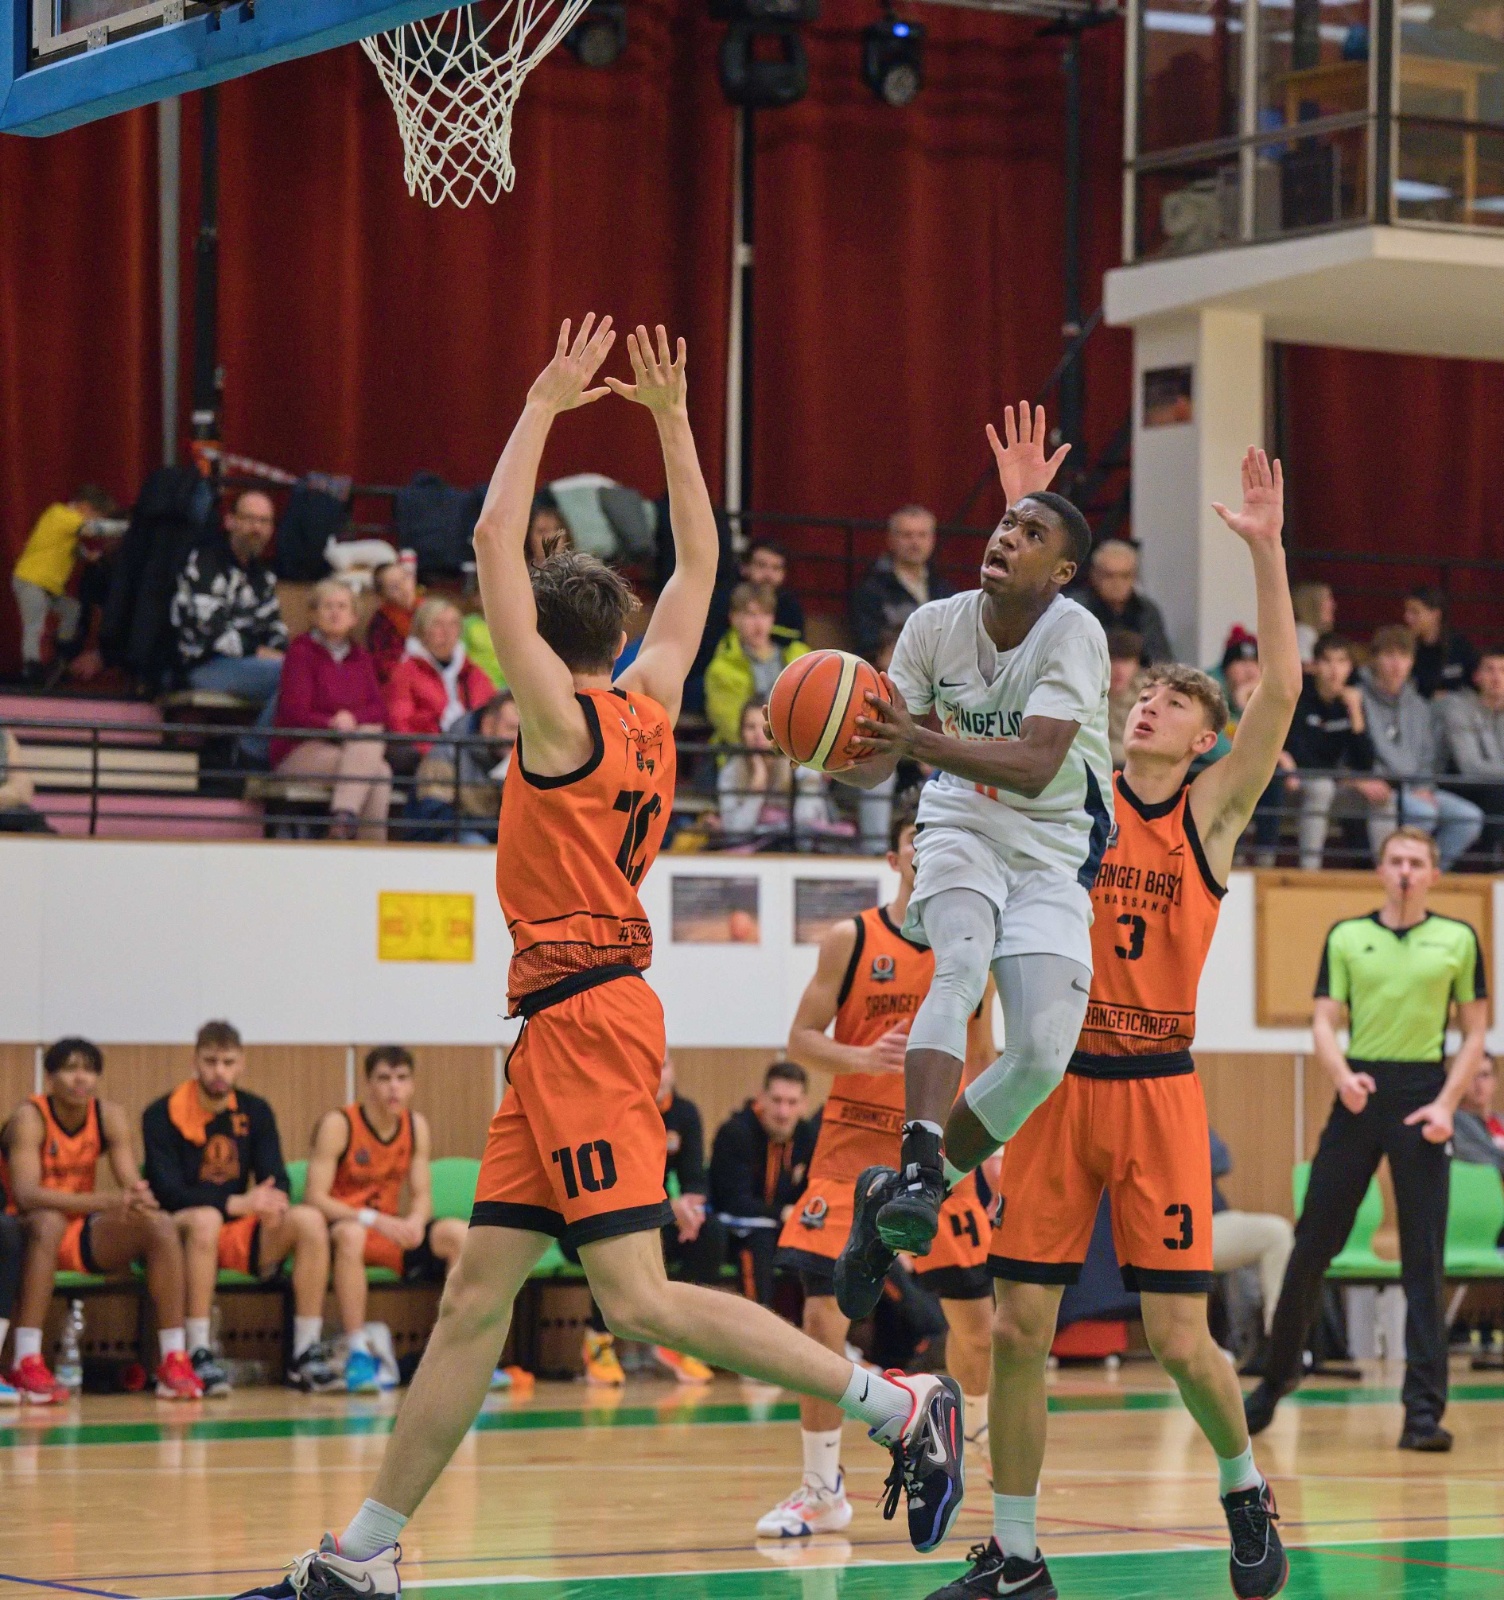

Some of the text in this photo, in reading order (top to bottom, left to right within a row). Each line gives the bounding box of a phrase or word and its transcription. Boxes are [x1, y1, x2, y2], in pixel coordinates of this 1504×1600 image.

[1093, 863, 1142, 890] ANGE1
[1104, 893, 1168, 914] BASSANO
[1114, 913, 1147, 961] 3
[551, 1139, 618, 1199] 10
[950, 1209, 980, 1247] 4
[1162, 1203, 1194, 1250] 3
